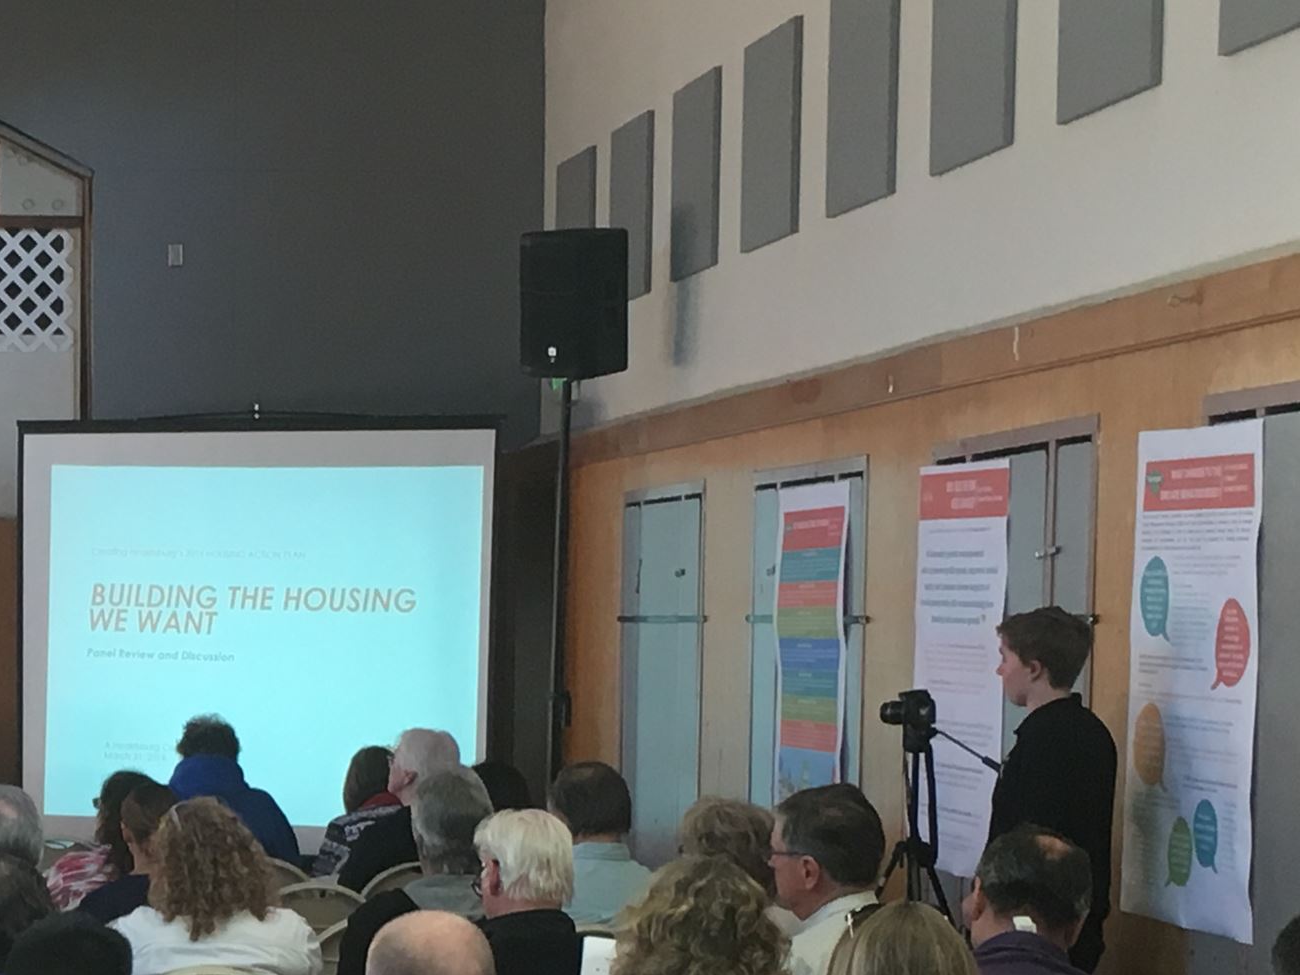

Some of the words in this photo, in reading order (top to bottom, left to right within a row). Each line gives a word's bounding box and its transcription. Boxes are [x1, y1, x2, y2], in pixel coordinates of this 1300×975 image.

[91, 583, 217, 609] BUILDING
[228, 585, 275, 611] THE
[283, 587, 417, 613] HOUSING
[90, 608, 129, 632] WE
[138, 609, 219, 635] WANT
[86, 647, 116, 658] Panel
[119, 648, 155, 659] Review
[157, 650, 179, 660] and
[181, 650, 236, 662] Discussion
